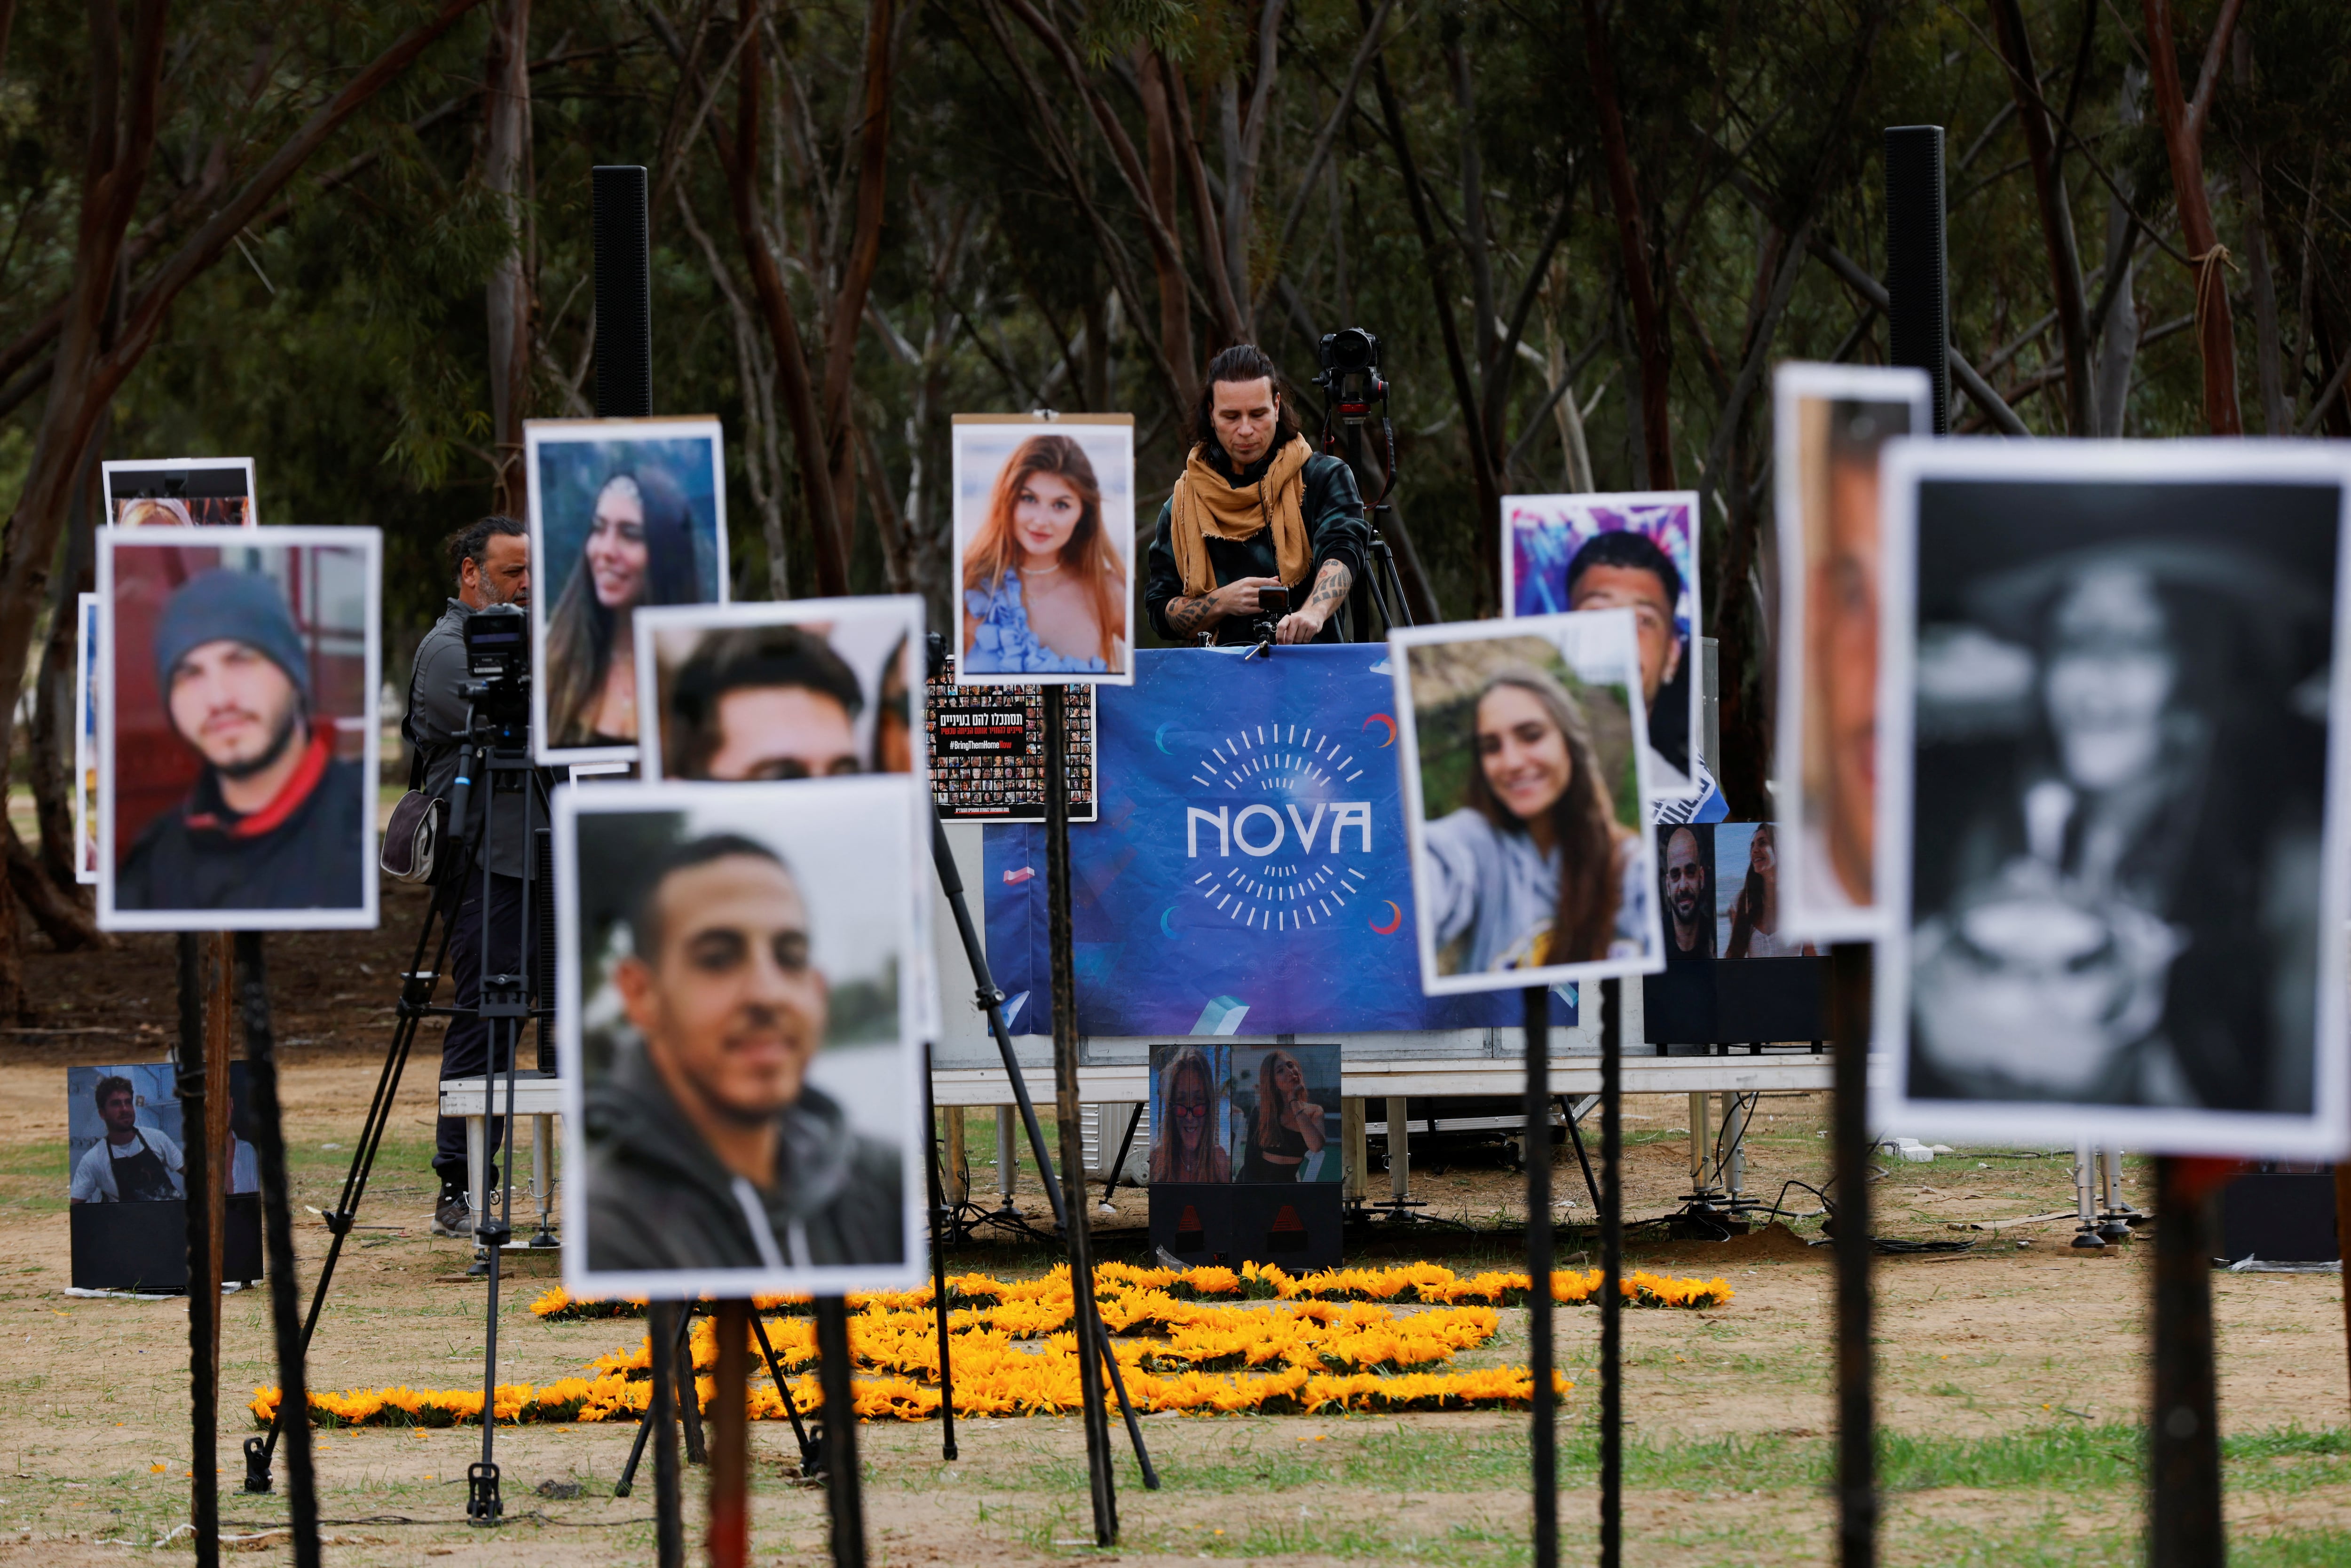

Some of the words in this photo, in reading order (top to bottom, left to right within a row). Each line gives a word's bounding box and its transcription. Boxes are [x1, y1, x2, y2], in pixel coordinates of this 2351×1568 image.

[940, 714, 970, 726] בעיניים
[972, 713, 988, 726] להם
[991, 713, 1023, 726] תסתכלו
[950, 740, 1011, 751] #BringThemHomeNow
[1187, 801, 1371, 858] NOVA
